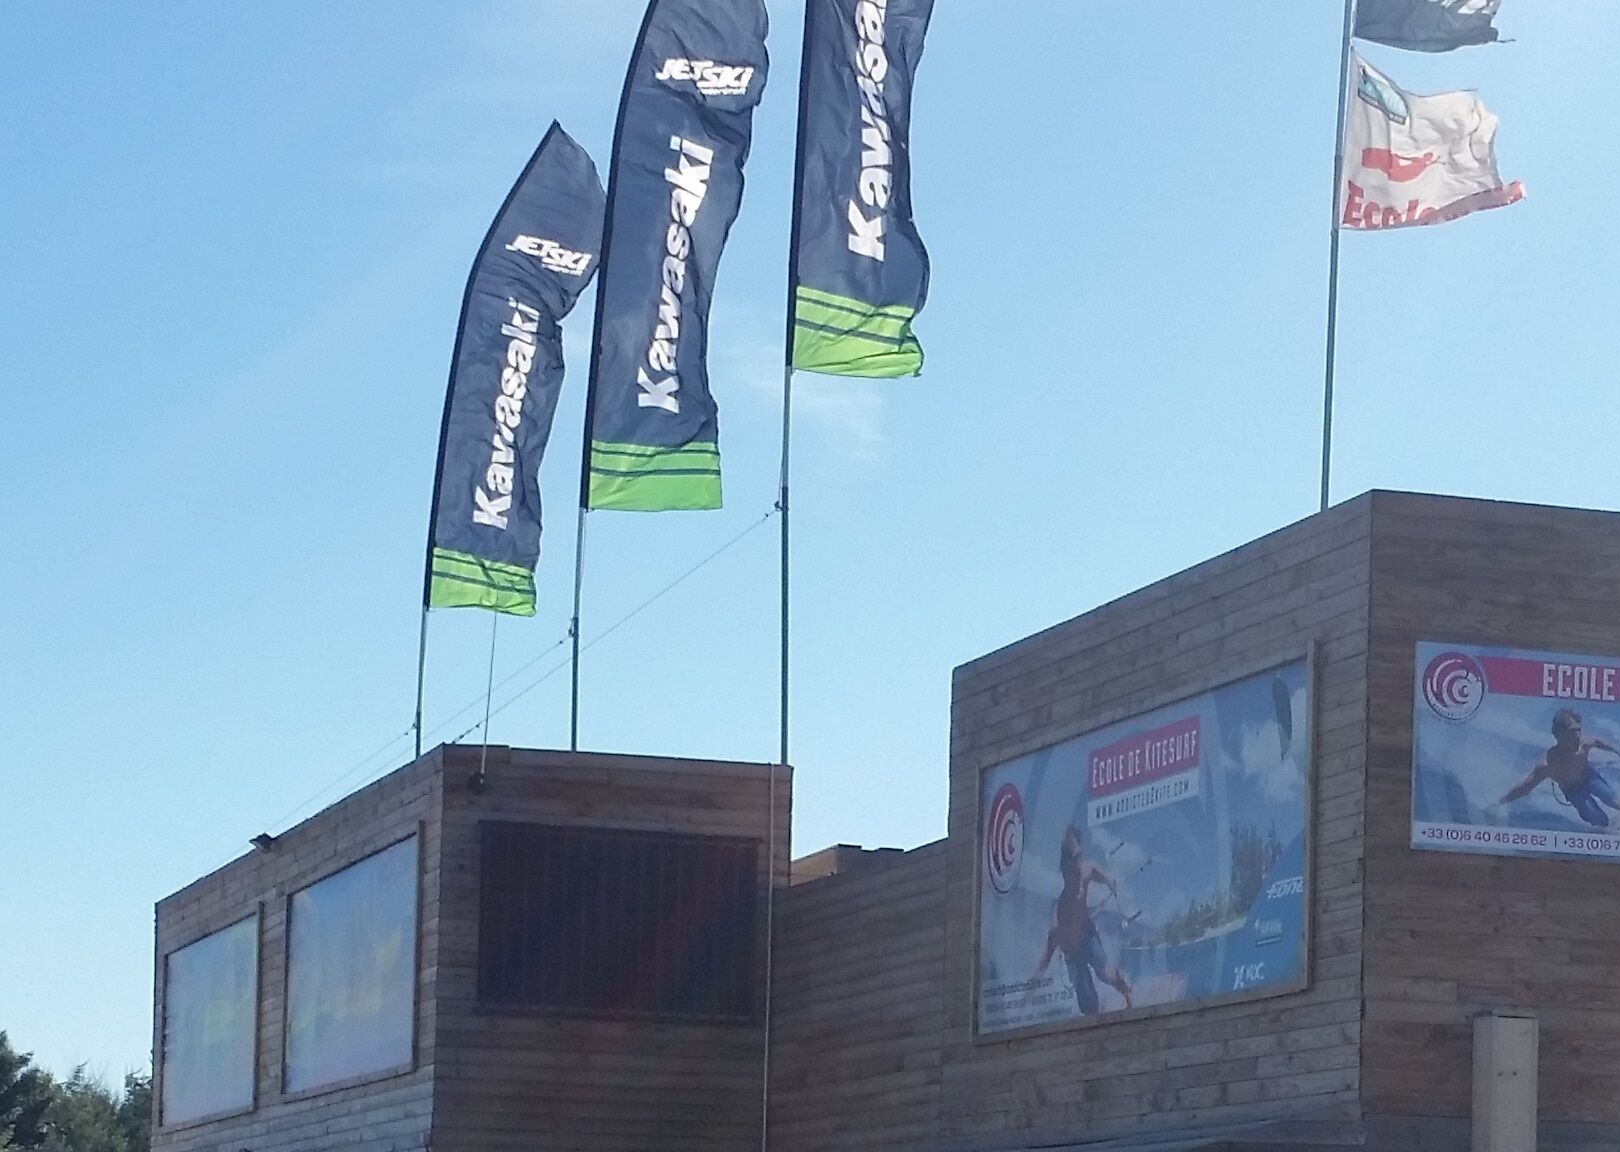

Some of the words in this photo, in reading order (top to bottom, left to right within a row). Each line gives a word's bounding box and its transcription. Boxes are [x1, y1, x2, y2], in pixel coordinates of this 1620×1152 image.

[848, 0, 893, 262] Kawasa
[638, 136, 714, 414] Kawasaki
[473, 298, 540, 529] Kawasaki
[1542, 663, 1615, 701] ECOLE
[1092, 754, 1124, 789] ECOLE
[1128, 749, 1140, 777] DE
[1145, 730, 1197, 771] KITESURF
[1421, 828, 1443, 839] +33
[1446, 829, 1471, 842] (0)6
[1474, 831, 1491, 842] 40
[1512, 833, 1528, 845] 26
[1530, 835, 1547, 846] 62
[1563, 837, 1584, 849] +33
[1586, 838, 1611, 851] (0)6
